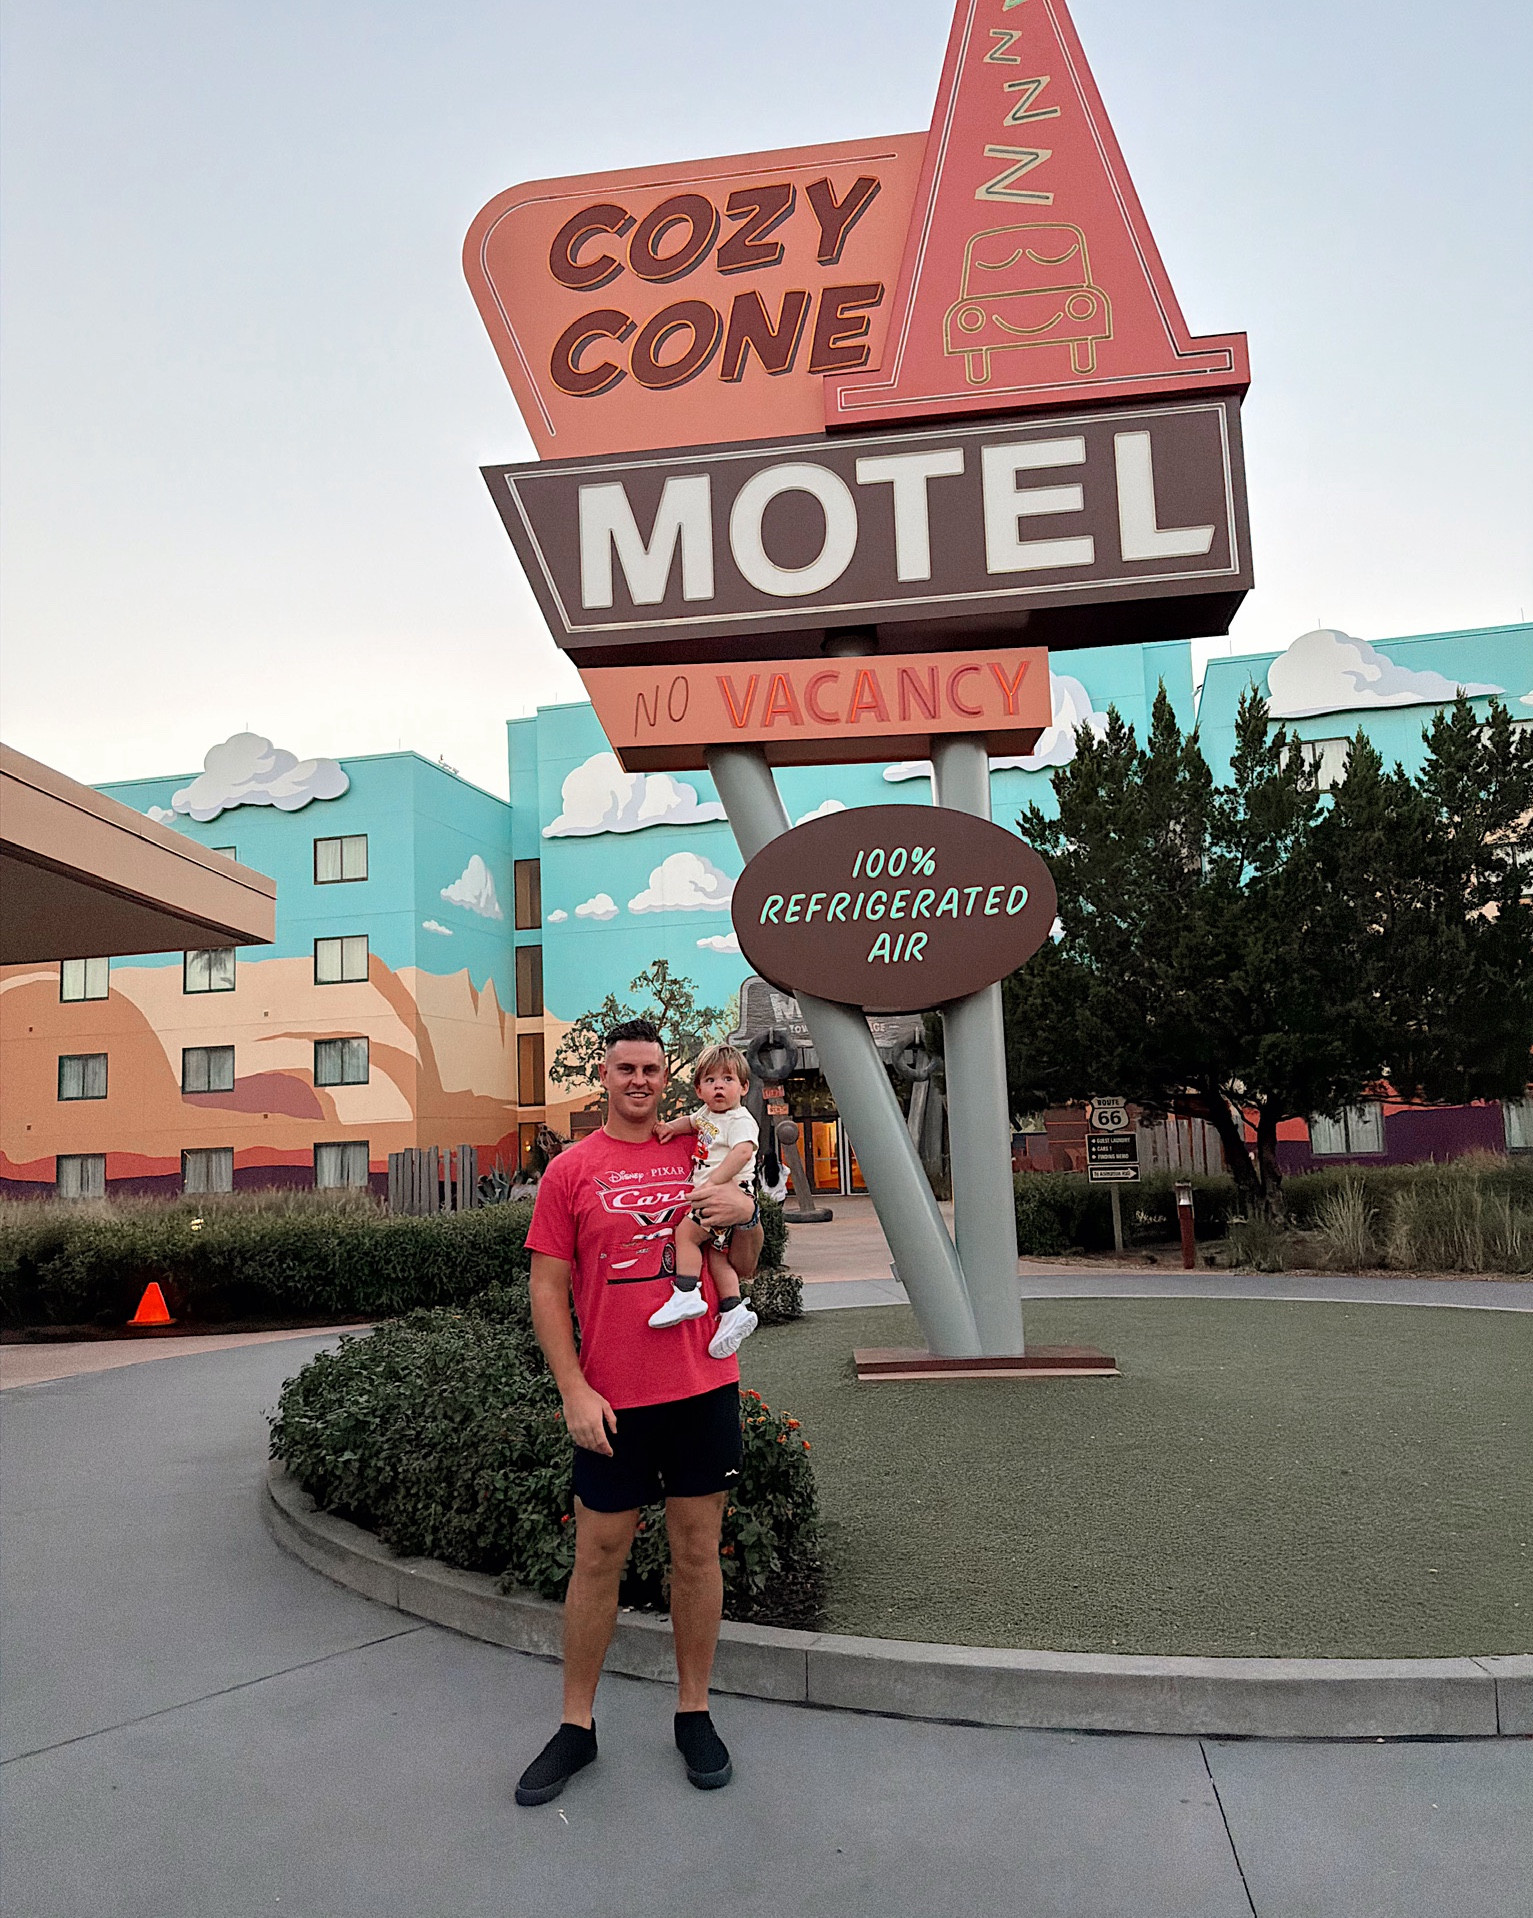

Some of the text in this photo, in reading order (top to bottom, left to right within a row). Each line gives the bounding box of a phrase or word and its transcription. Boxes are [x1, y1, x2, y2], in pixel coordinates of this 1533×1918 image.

[549, 175, 881, 290] COZY
[549, 283, 884, 397] CONE
[578, 430, 1215, 609] MOTEL
[634, 660, 1033, 737] NO VACANCY
[852, 846, 937, 879] 100%
[759, 885, 1029, 925] REFRIGERATED
[867, 932, 929, 964] AIR
[1098, 1110, 1122, 1125] 66
[651, 1166, 686, 1177] PIXAR
[612, 1190, 686, 1208] Cars
